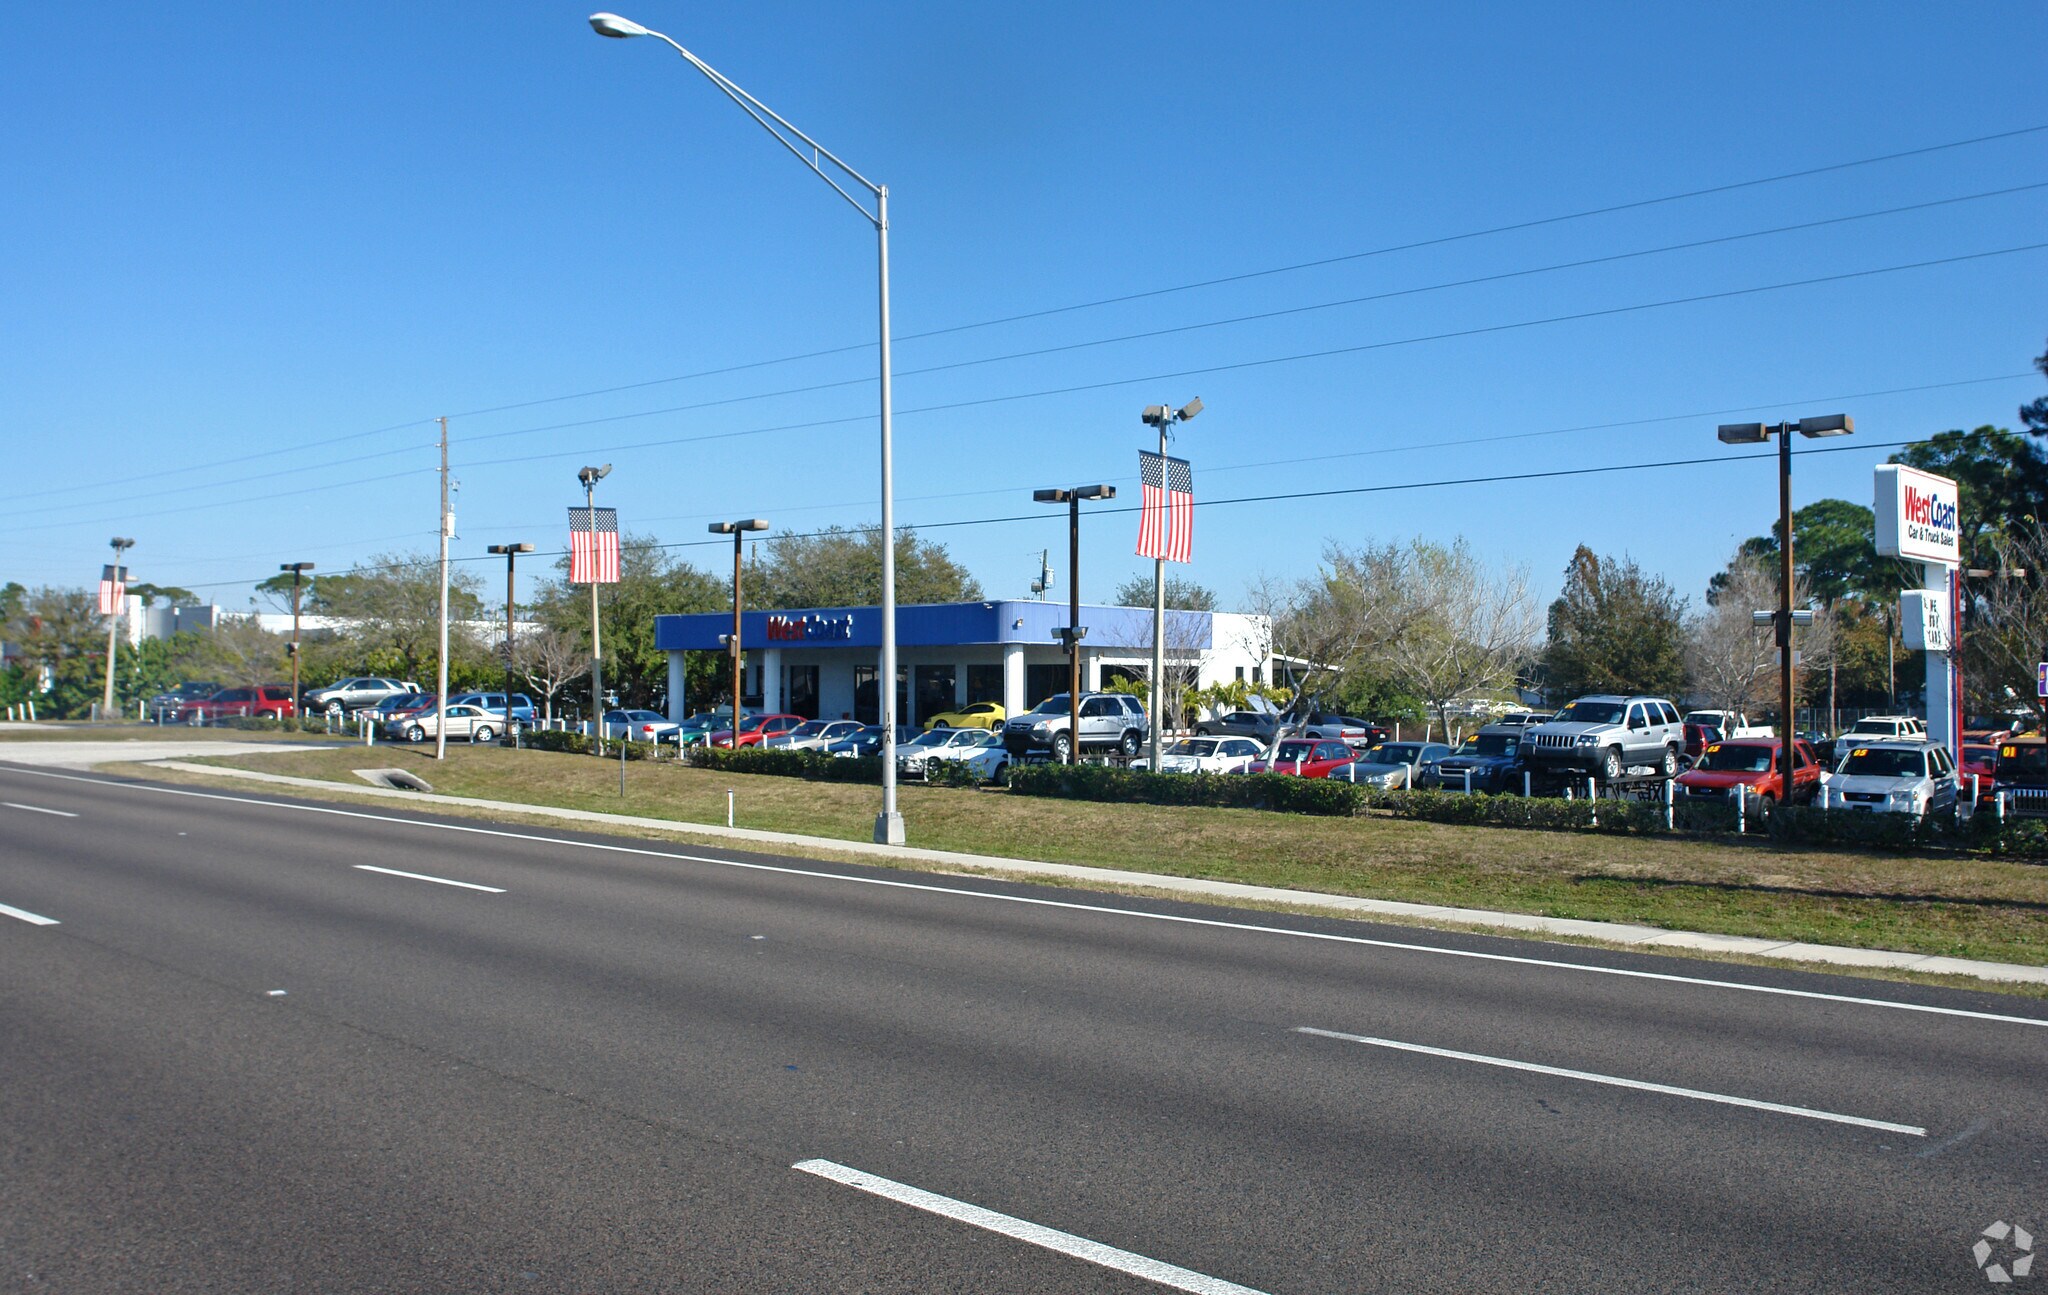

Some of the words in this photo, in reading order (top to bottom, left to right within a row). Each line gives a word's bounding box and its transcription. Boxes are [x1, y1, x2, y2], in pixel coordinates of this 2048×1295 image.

[1908, 524, 1918, 540] Car
[1925, 528, 1939, 544] Truck
[1940, 531, 1954, 547] Sales
[1853, 749, 1868, 757] 05
[2002, 746, 2016, 758] 01
